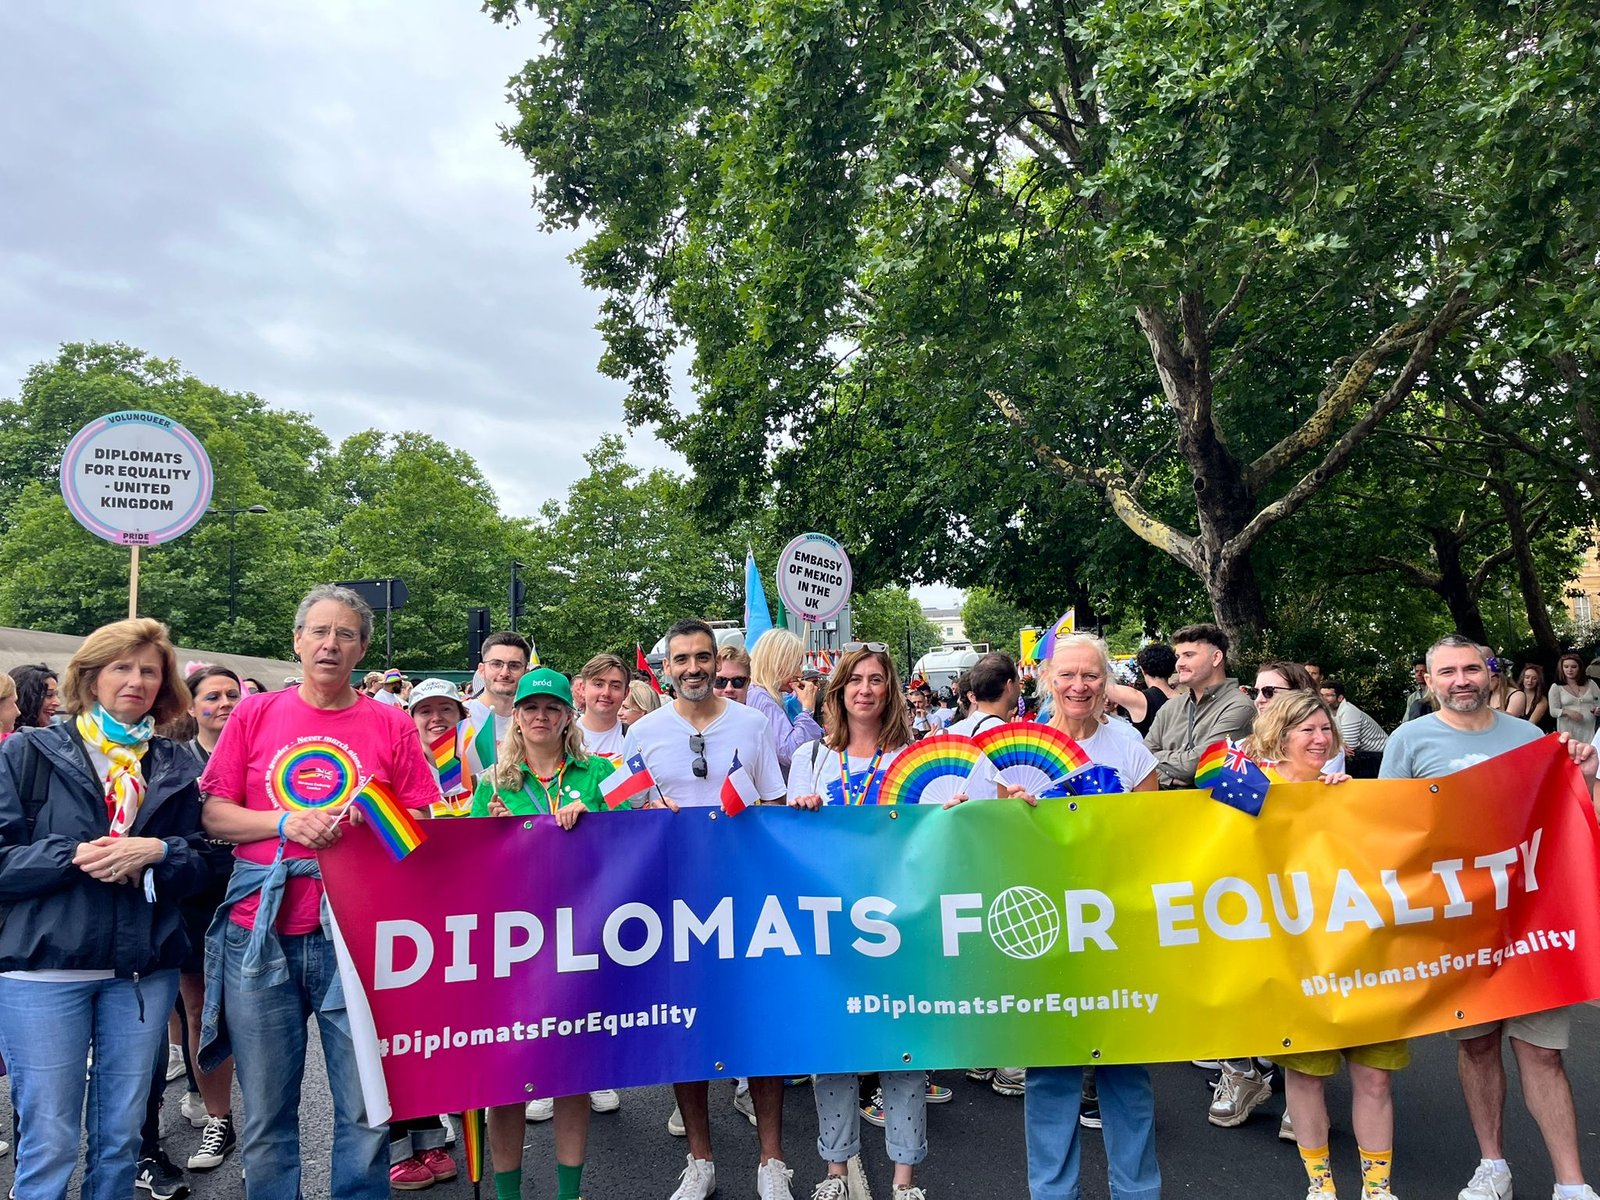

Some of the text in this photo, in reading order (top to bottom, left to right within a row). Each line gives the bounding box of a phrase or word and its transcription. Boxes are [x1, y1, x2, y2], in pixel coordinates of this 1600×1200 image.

[108, 413, 171, 428] VOLUNQUEER
[95, 448, 182, 464] DIPLOMATS
[84, 464, 191, 481] FOR EQUALITY
[114, 481, 171, 495] UNITED
[100, 496, 173, 511] KINGDOM
[123, 532, 149, 540] PRIDE
[794, 551, 842, 572] EMBASSY
[789, 564, 842, 586] OF MEXICO
[798, 581, 830, 598] IN THE
[805, 597, 820, 609] UK
[532, 679, 552, 687] bród
[297, 735, 323, 743] Never
[323, 736, 349, 751] march
[373, 894, 901, 991] DIPLOMATS
[1151, 828, 1543, 947] EQUALITY
[1301, 927, 1577, 999] #DiplomatsForEquality
[846, 990, 1159, 1019] #DiplomatsForEquality
